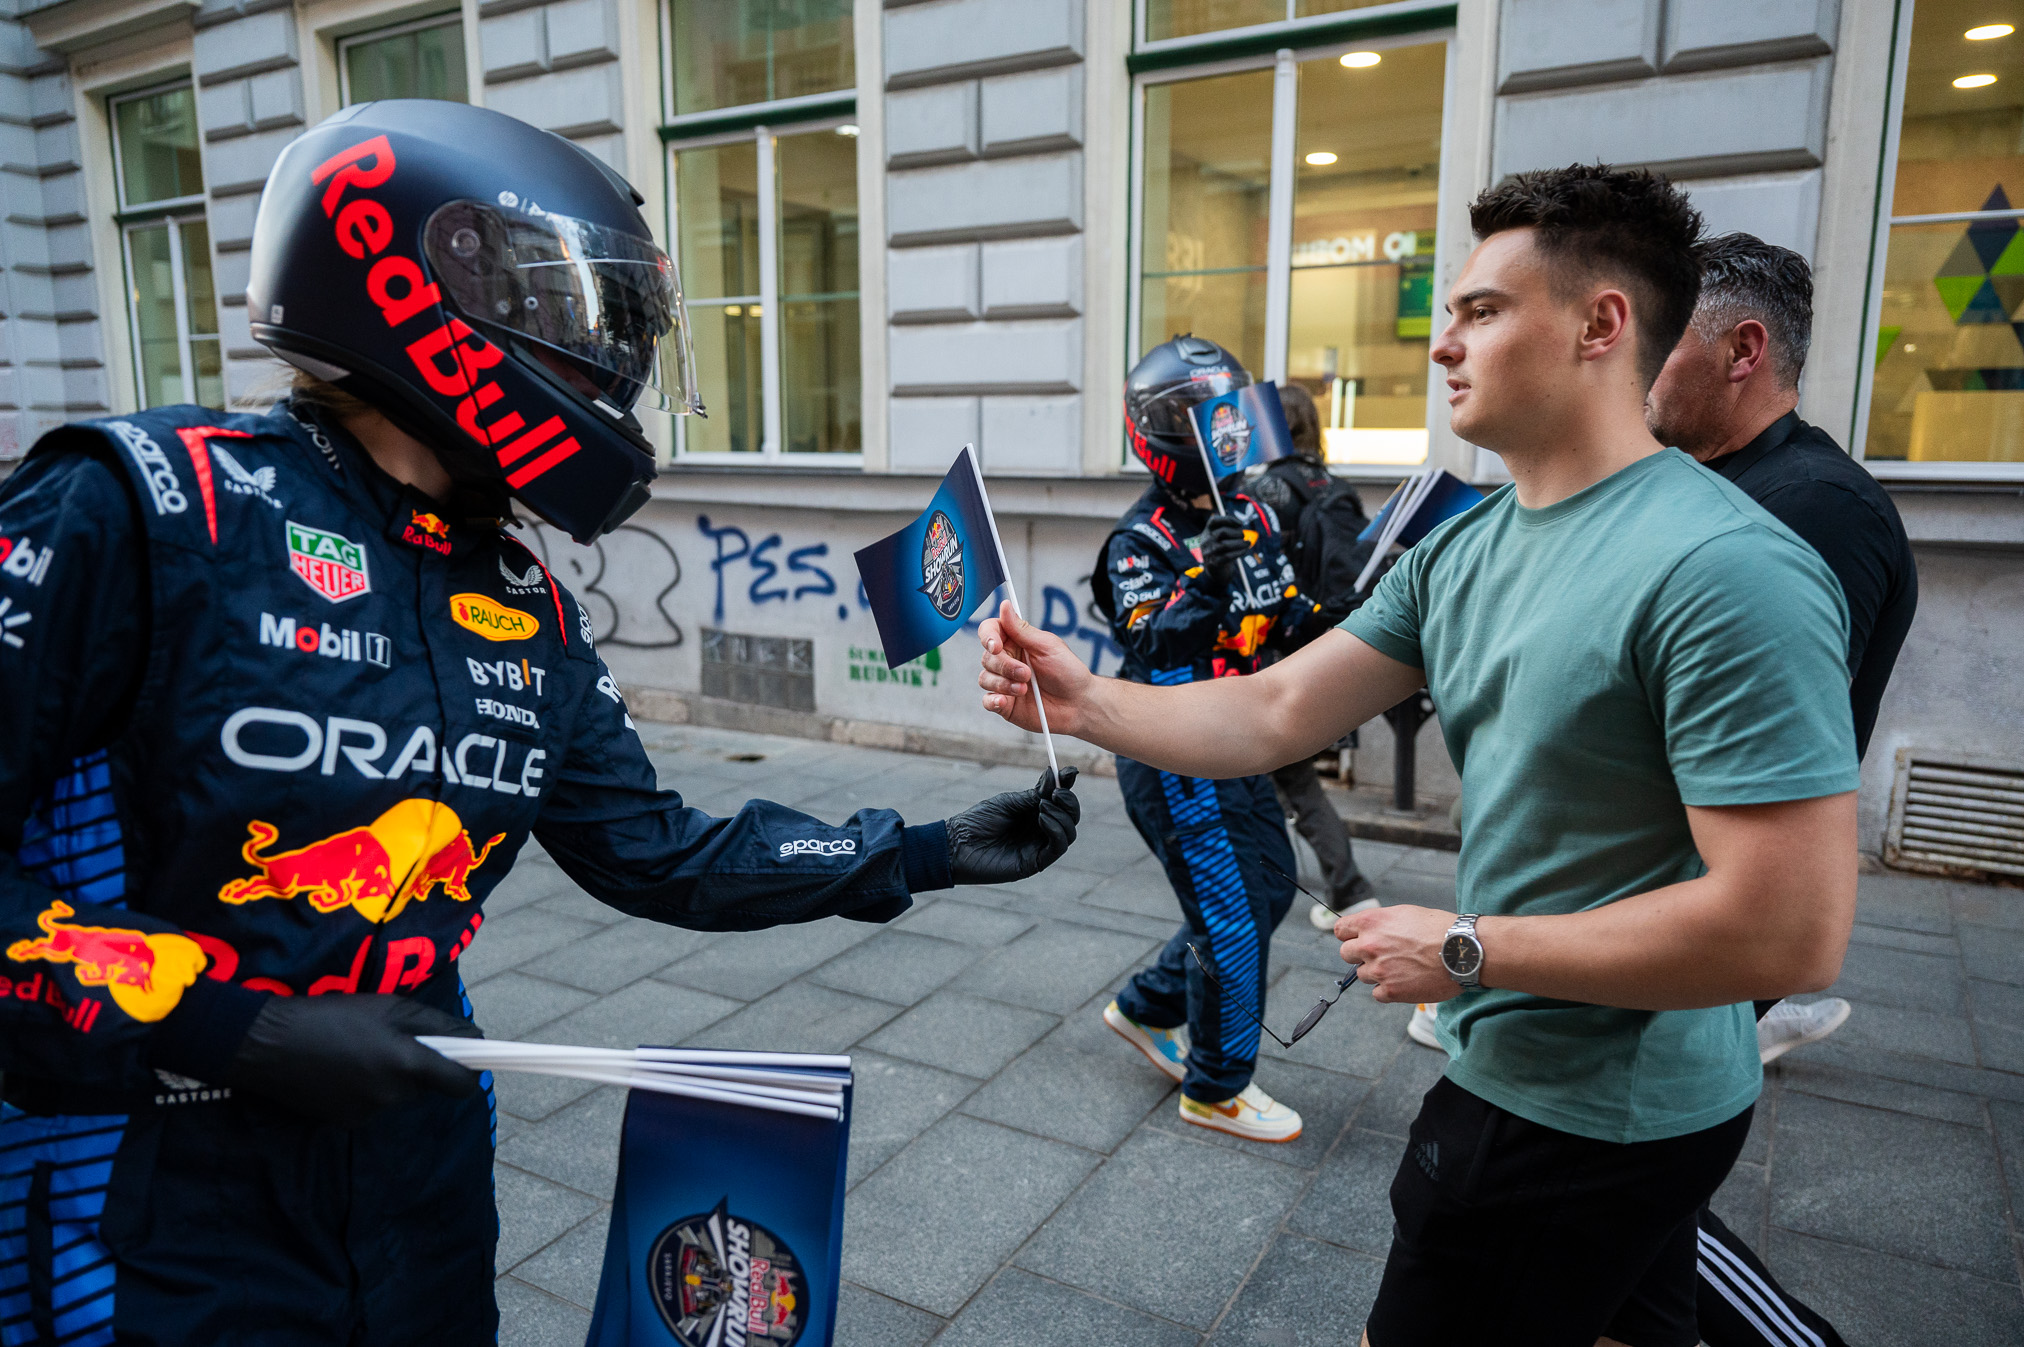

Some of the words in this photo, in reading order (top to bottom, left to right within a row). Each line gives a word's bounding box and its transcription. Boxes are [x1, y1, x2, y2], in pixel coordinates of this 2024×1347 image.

[292, 528, 359, 568] TAG
[925, 533, 959, 583] SHOWRUN
[292, 554, 363, 597] HEUER
[506, 586, 547, 595] CASTOR
[260, 612, 361, 662] Mobil
[469, 605, 526, 633] RAUCH
[466, 656, 546, 696] BYBIT
[220, 705, 548, 798] ORACLE
[779, 838, 856, 857] sparco
[154, 1087, 233, 1105] CASTORE
[725, 1218, 750, 1347] SHOWRU
